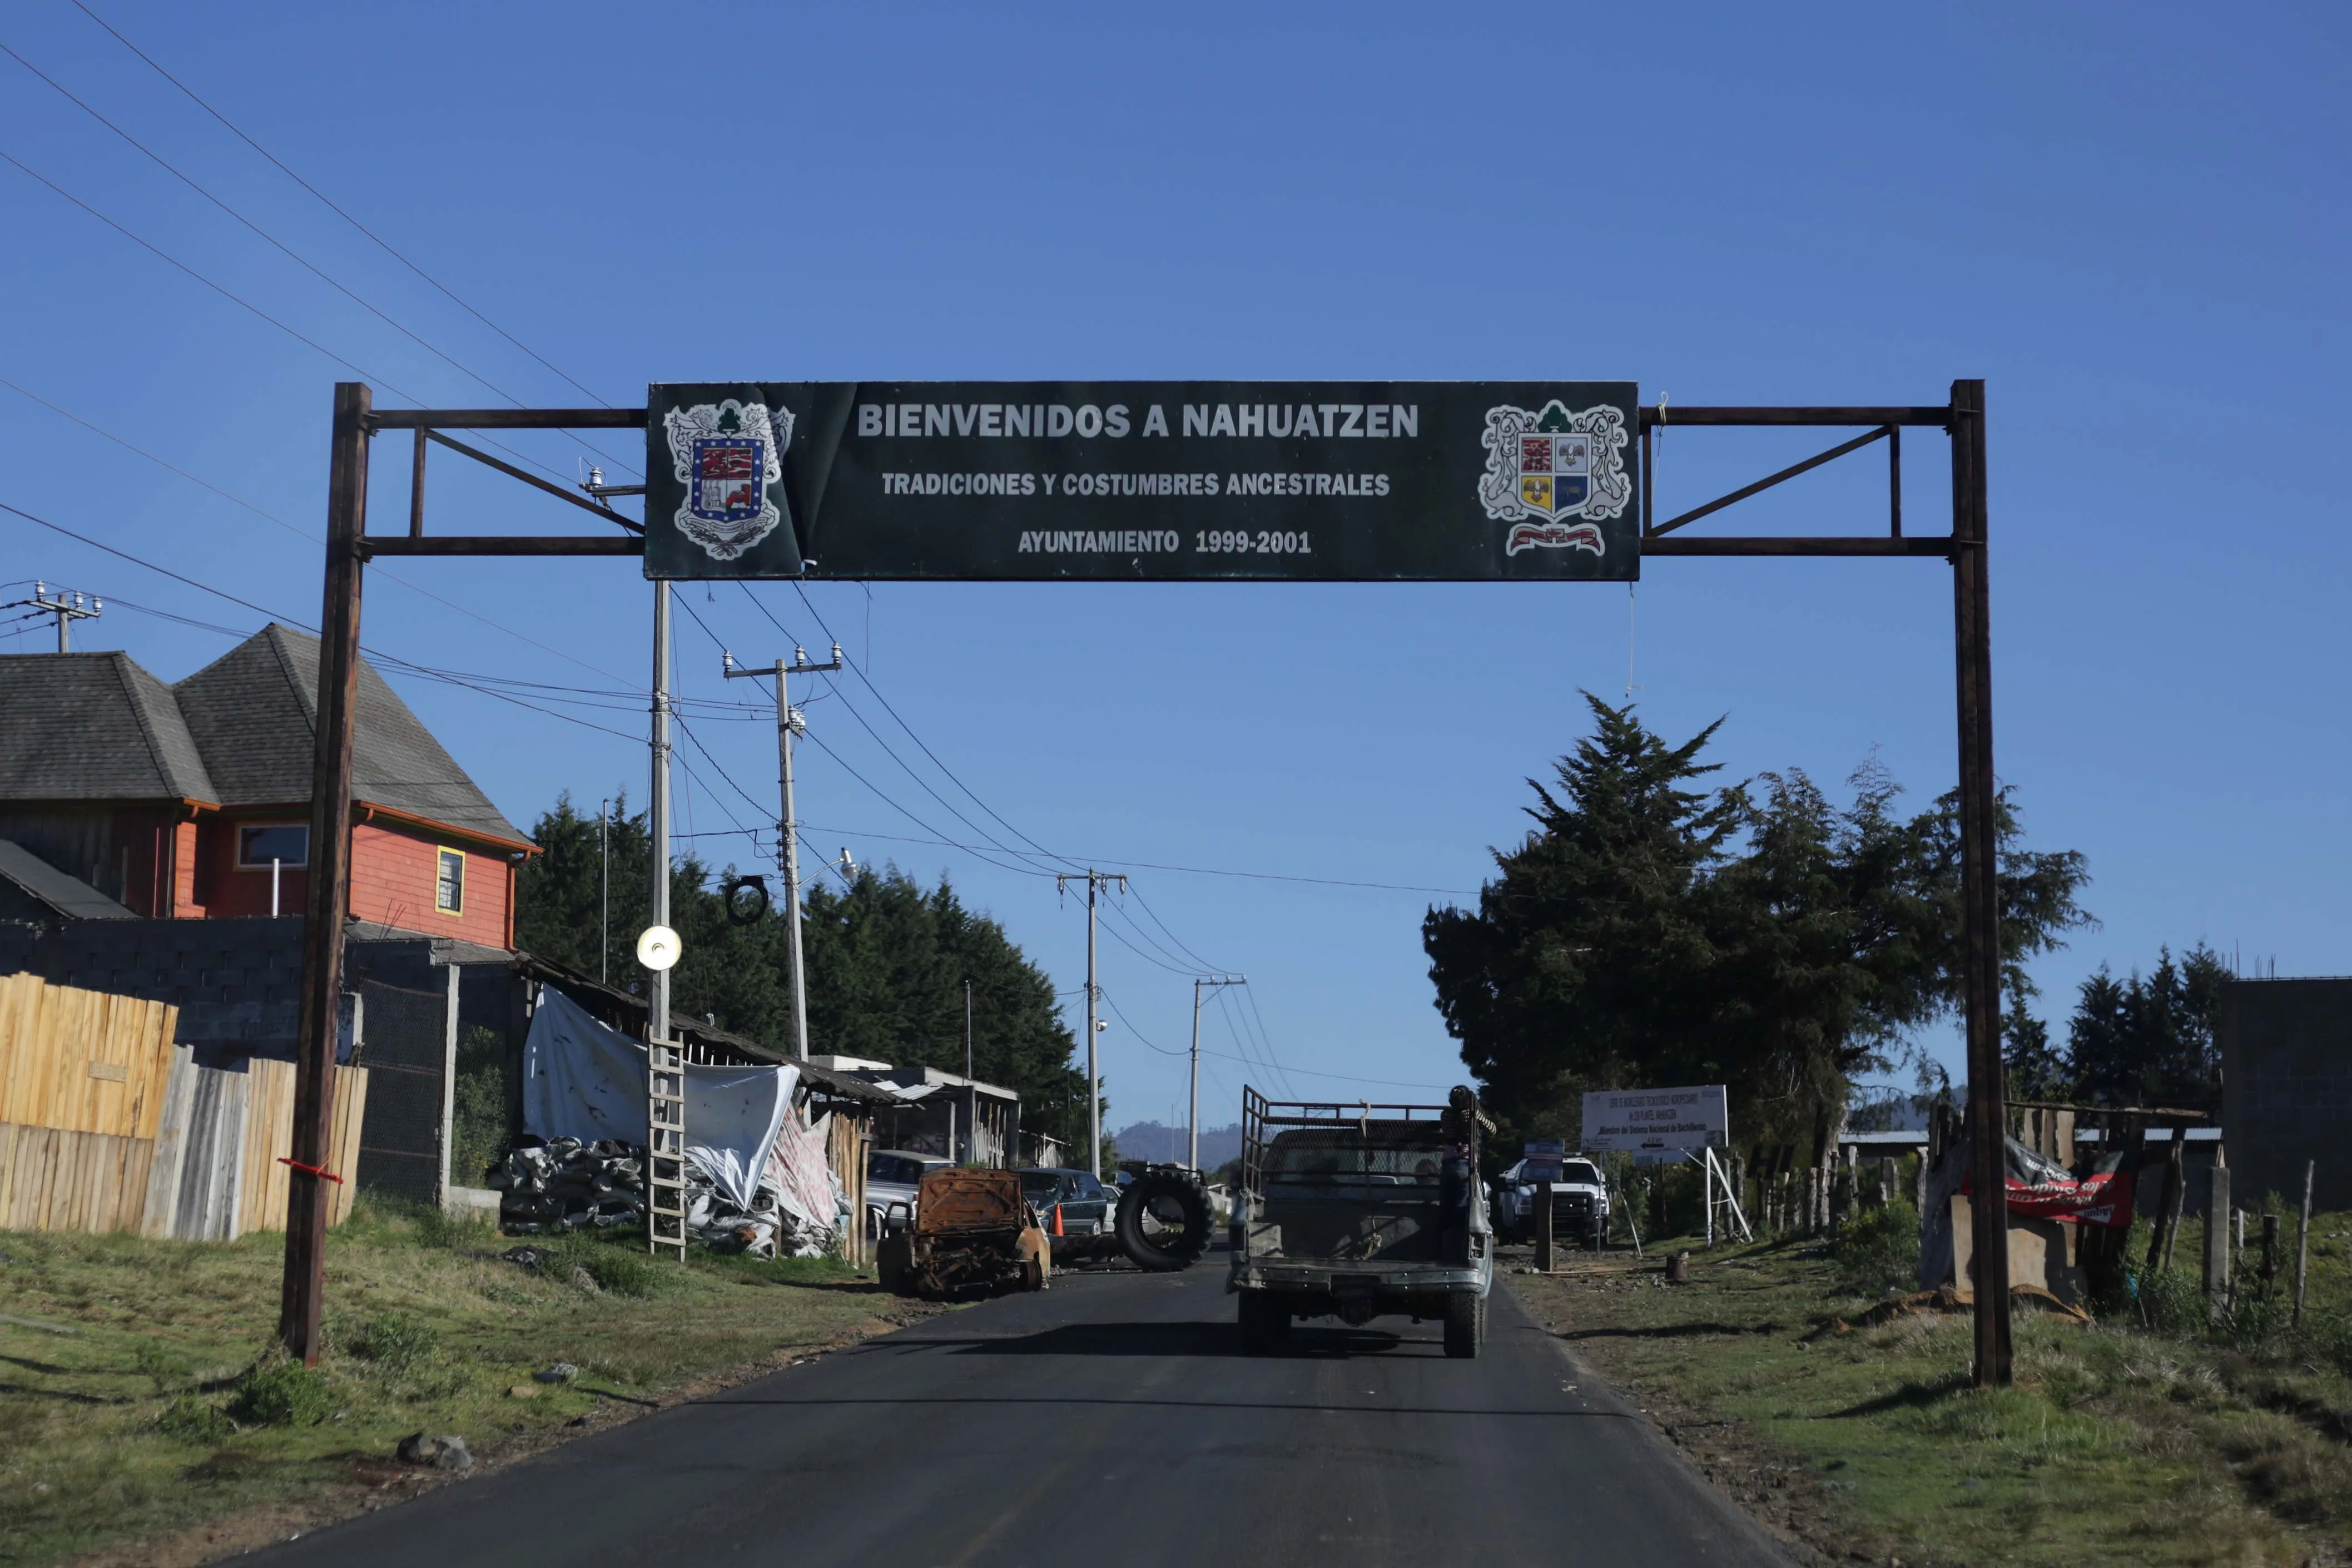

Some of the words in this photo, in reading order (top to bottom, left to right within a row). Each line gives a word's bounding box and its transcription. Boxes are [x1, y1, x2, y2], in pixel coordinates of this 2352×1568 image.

[858, 404, 1130, 438] BIENVENIDOS
[1143, 404, 1169, 436] A
[1183, 404, 1418, 438] NAHUATZEN
[882, 473, 1035, 495] TRADICIONES
[1041, 474, 1056, 495] Y
[1063, 473, 1219, 495] COSTUMBRES
[1225, 473, 1390, 496] ANCESTRALES
[1018, 530, 1179, 553] AYUNTAMIENTO
[1195, 530, 1311, 553] 1999-2001
[1600, 1125, 1620, 1135] Miembro
[1629, 1124, 1648, 1134] Sistema
[1649, 1124, 1670, 1134] Nacional
[1670, 1123, 1676, 1132] de
[1678, 1122, 1707, 1132] Bachillerato
